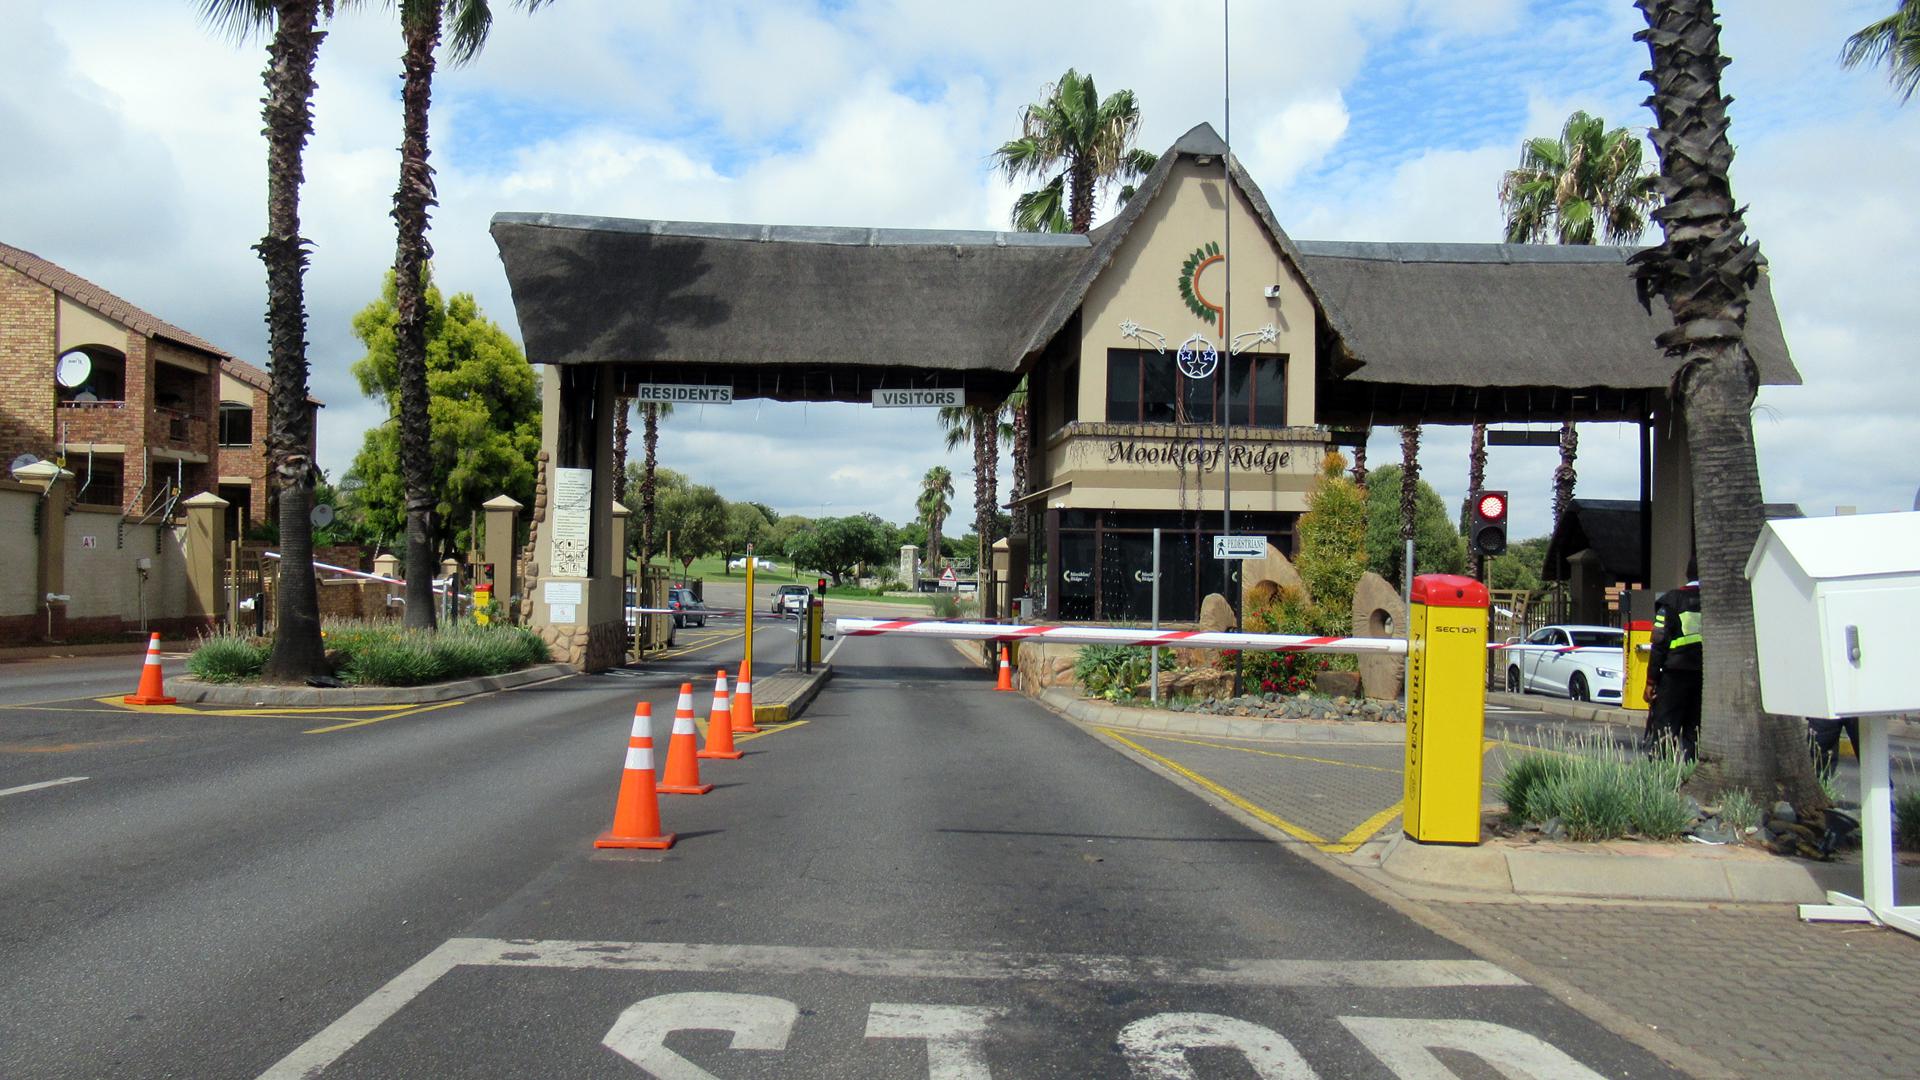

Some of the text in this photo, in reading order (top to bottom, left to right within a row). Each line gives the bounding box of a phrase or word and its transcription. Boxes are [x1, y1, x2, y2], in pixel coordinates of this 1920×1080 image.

[641, 387, 730, 401] RESIDENTS
[882, 391, 956, 405] VISITORS
[1108, 440, 1290, 475] Mooikloof Ridge
[1227, 539, 1264, 549] PEDESTRIANS
[1435, 625, 1477, 634] SECTOR
[1410, 633, 1421, 767] CENTURION
